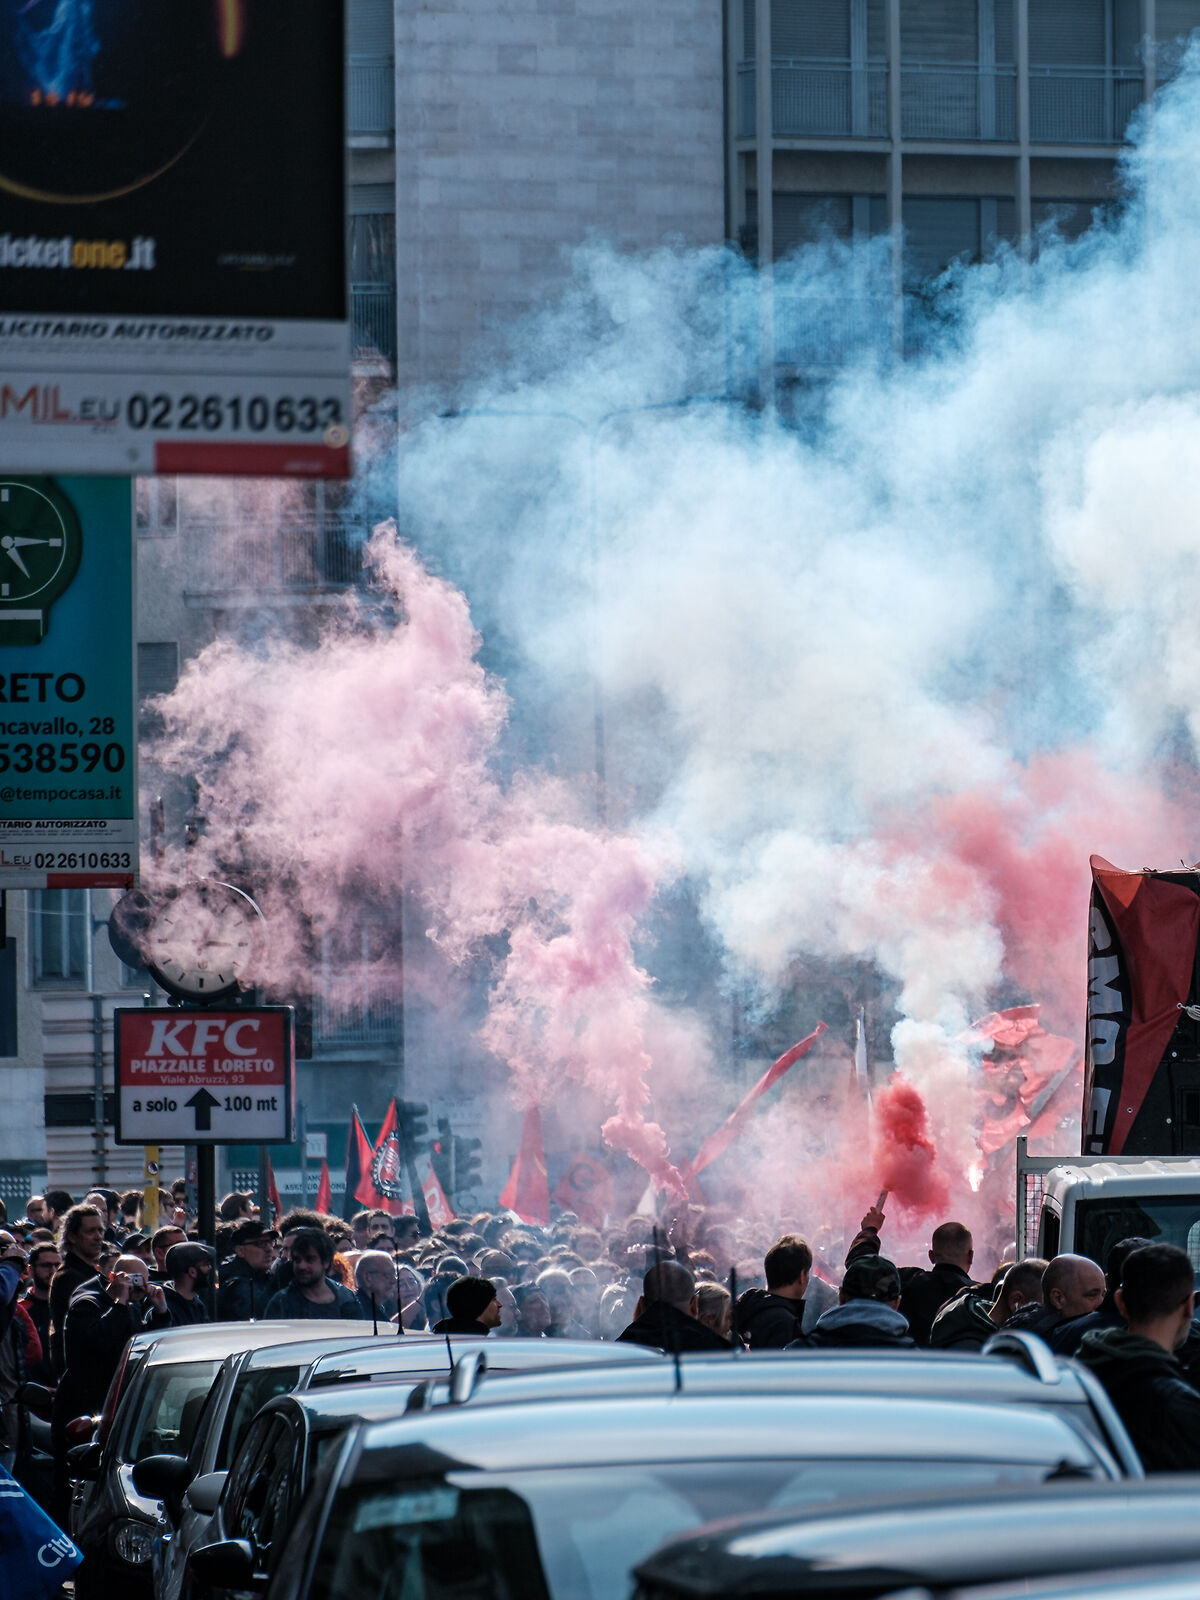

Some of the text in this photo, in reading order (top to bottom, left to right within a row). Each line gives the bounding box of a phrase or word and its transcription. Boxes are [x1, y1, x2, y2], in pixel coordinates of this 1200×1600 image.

[111, 322, 275, 342] AUTORIZZATO
[89, 717, 115, 735] 28
[35, 820, 107, 829] AUTORIZZATO
[144, 1018, 261, 1057] KFC
[130, 1058, 275, 1074] PIAZZALE LORETO
[160, 1074, 245, 1086] Viale Abruzzi, 93
[133, 1096, 278, 1113] a solo 100 mt
[37, 1534, 78, 1568] City
